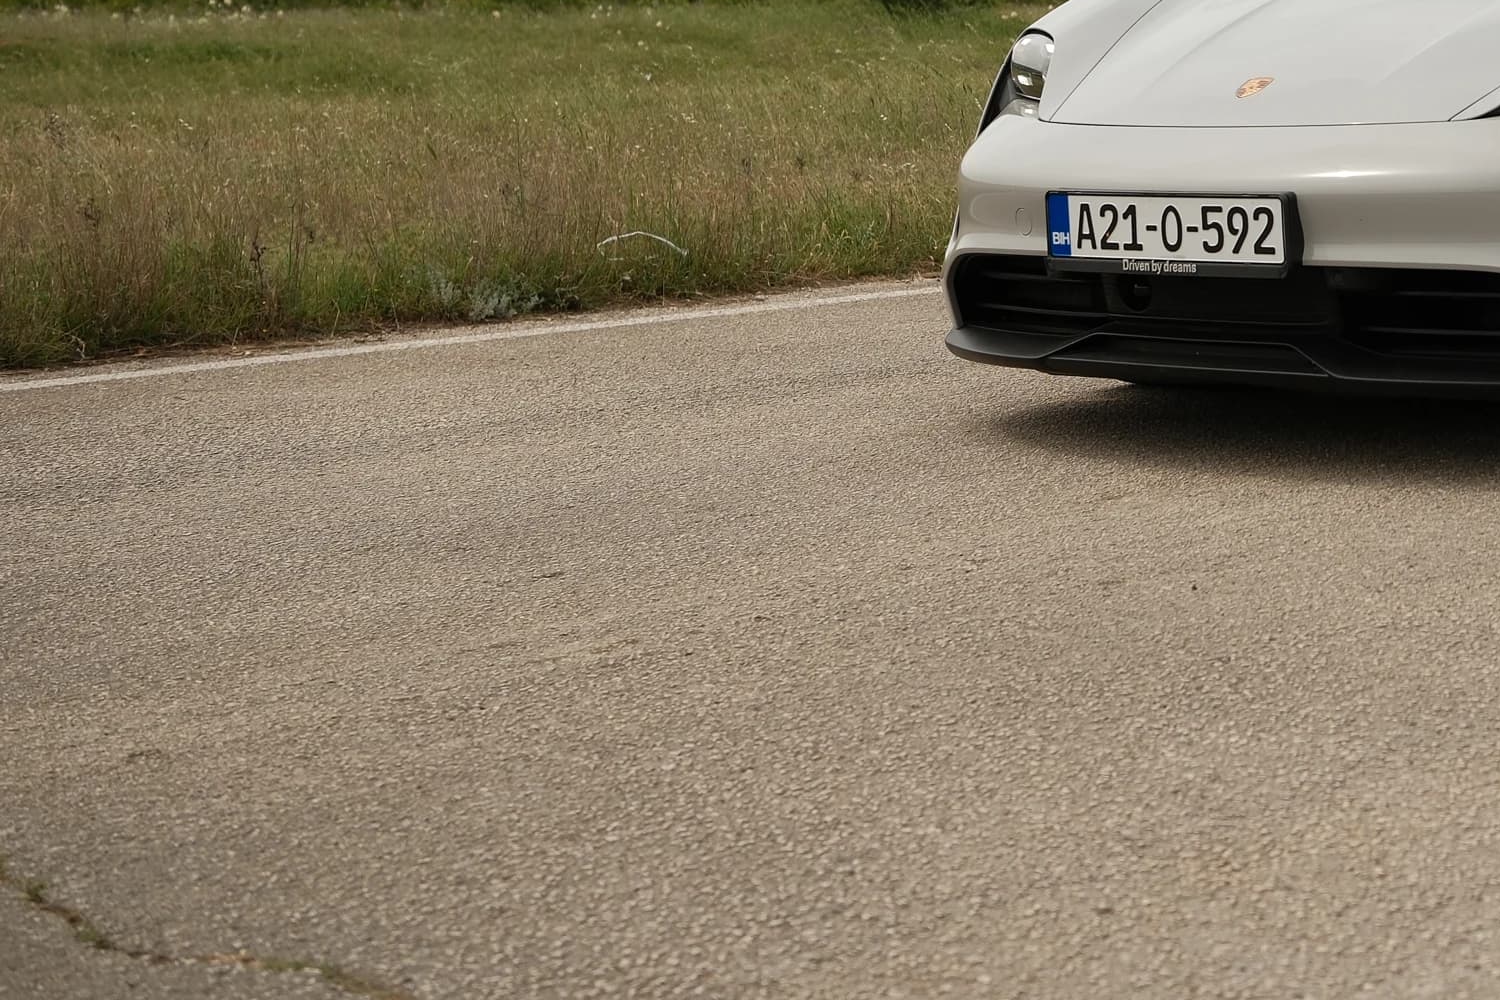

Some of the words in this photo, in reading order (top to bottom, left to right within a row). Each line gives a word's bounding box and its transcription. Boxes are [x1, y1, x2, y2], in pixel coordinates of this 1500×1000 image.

[1052, 231, 1070, 245] BIH
[1122, 259, 1150, 272] Driven
[1151, 260, 1161, 275] by
[1163, 261, 1197, 273] dreams
